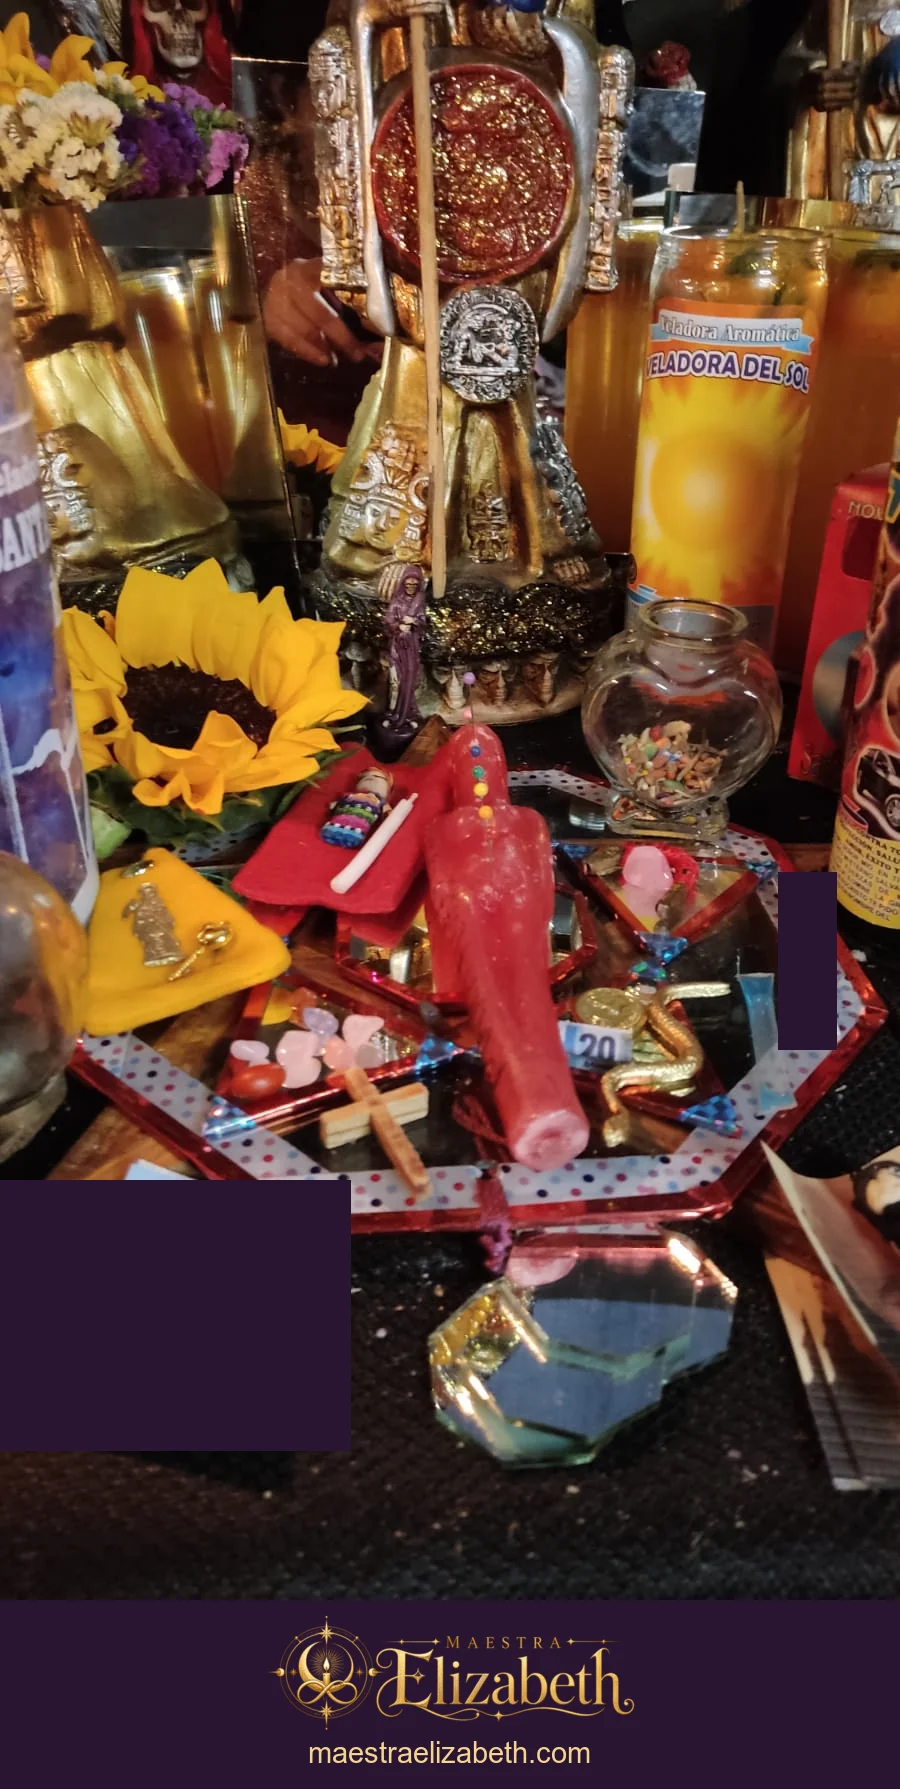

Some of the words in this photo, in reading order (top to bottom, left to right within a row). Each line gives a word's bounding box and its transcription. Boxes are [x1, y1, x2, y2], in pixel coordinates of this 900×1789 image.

[660, 314, 718, 340] Veladora
[724, 322, 801, 343] Aromática
[743, 355, 782, 382] DEL
[785, 363, 809, 392] SOL
[579, 1033, 616, 1060] 20
